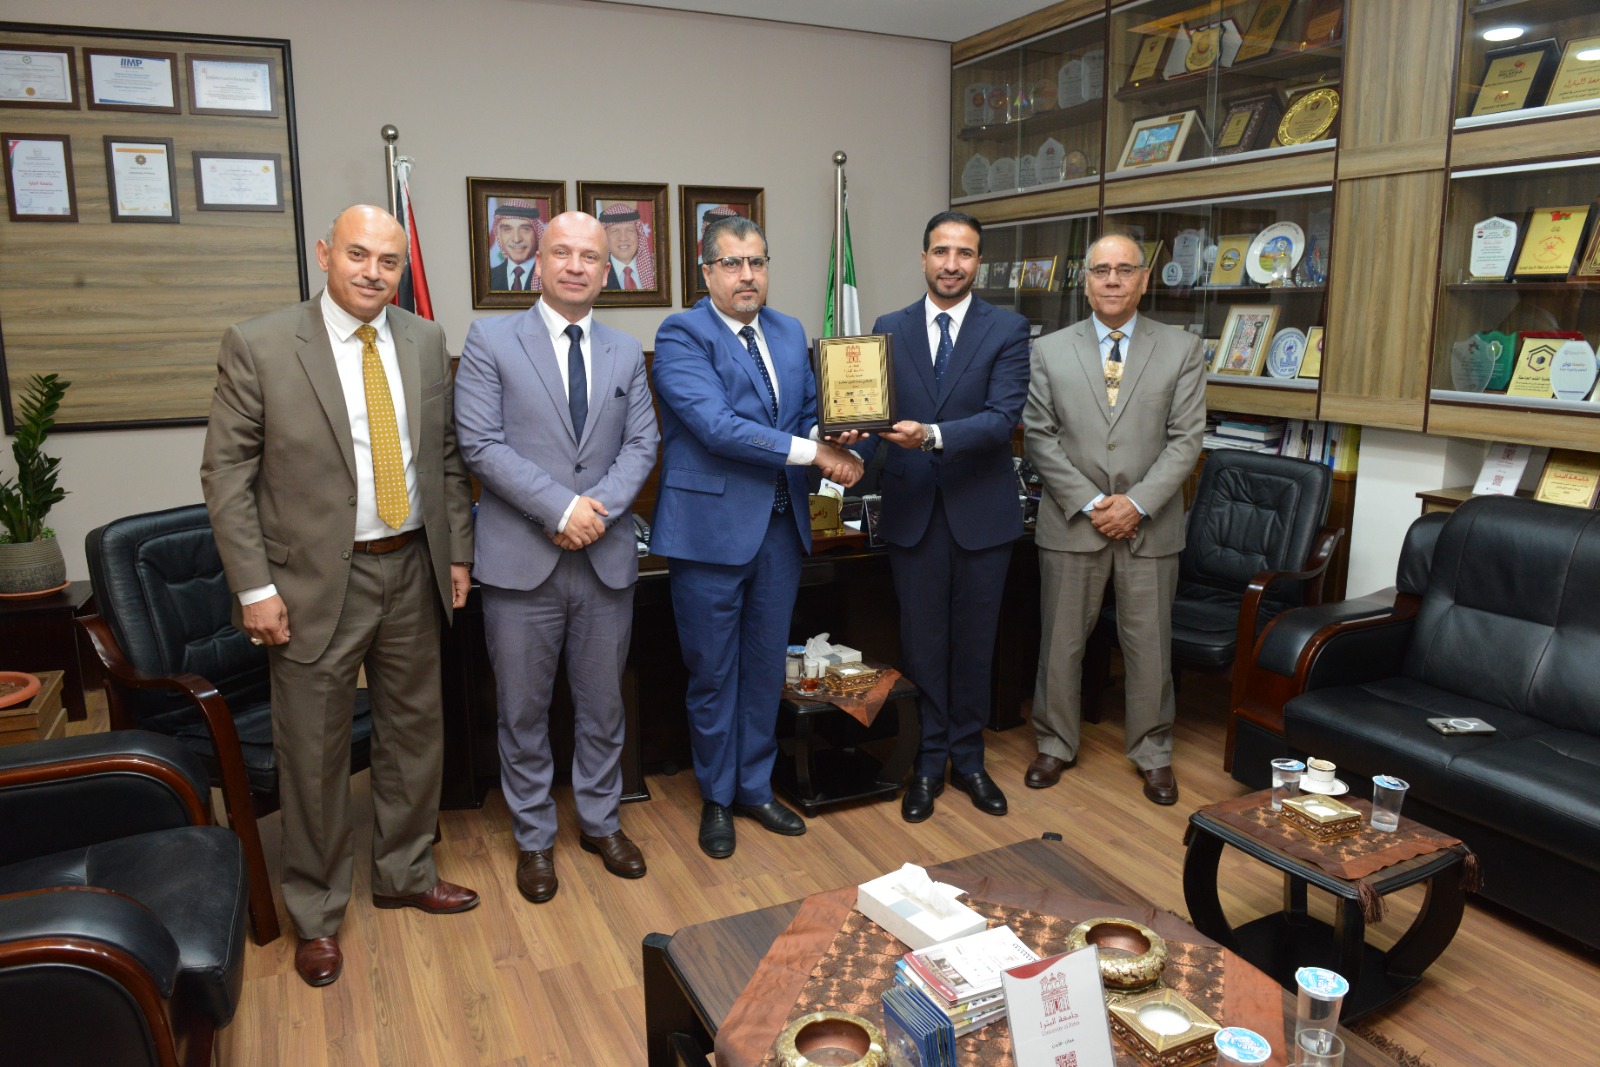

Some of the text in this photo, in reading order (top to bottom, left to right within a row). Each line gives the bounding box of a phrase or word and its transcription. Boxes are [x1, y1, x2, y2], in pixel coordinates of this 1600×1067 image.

[121, 58, 143, 67] IIMP
[1040, 1012, 1079, 1029] جامعة البترا
